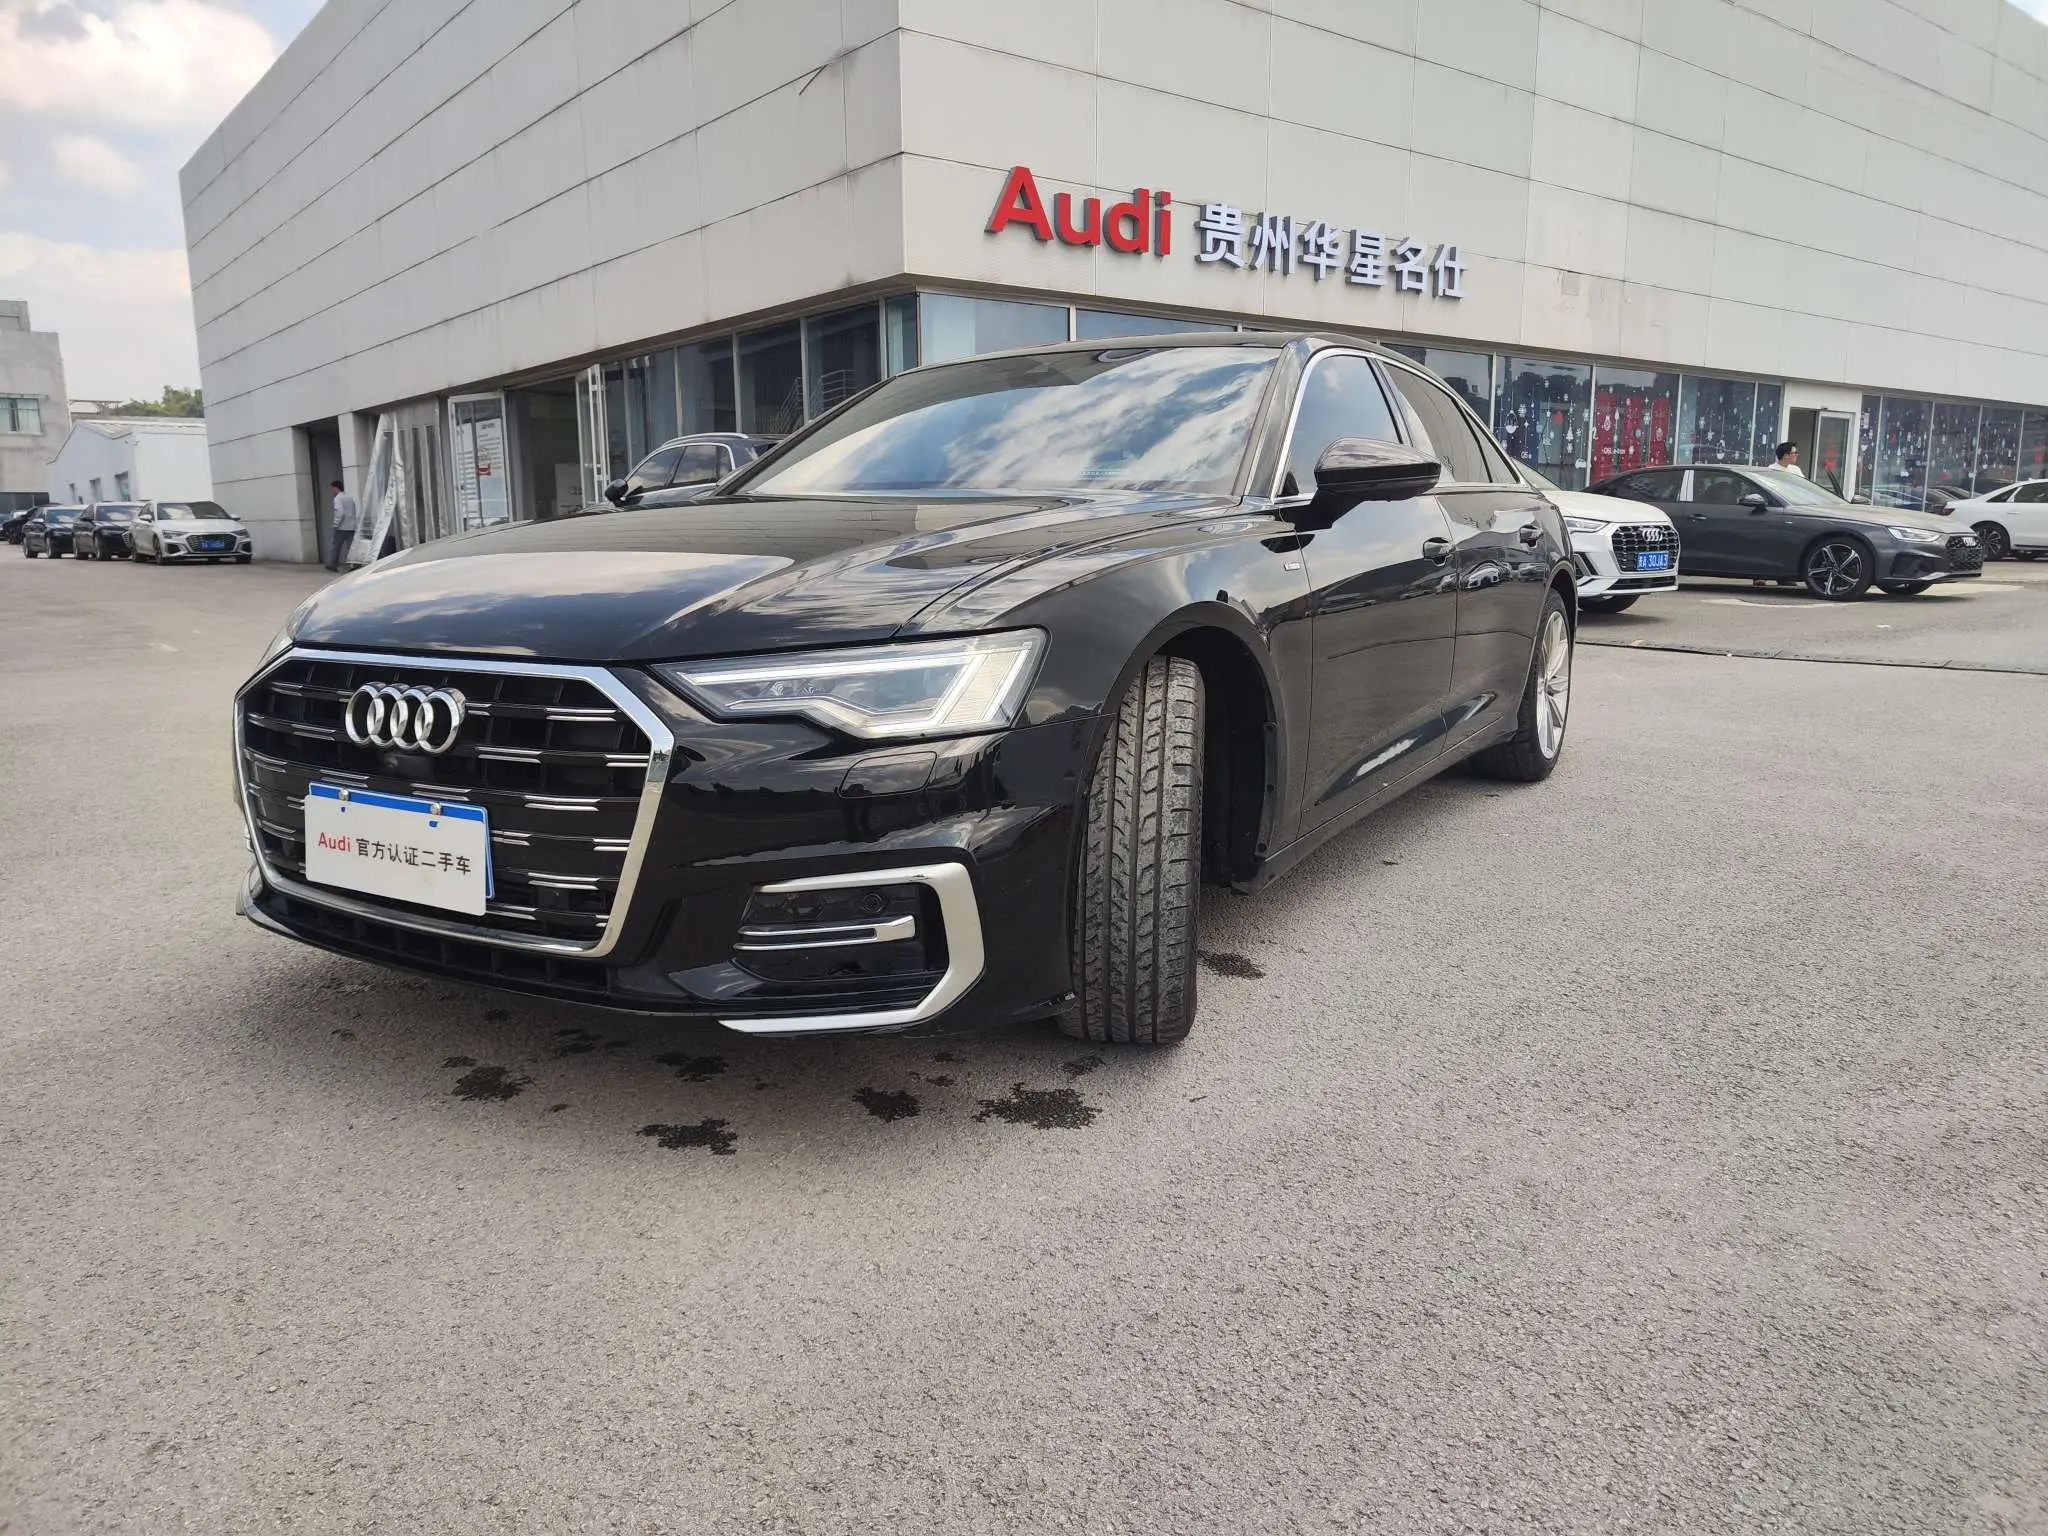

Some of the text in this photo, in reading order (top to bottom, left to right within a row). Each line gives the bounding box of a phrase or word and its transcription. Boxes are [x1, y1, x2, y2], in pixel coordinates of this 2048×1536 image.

[985, 166, 1171, 257] Audi
[1195, 203, 1470, 300] 贵州华星名仕
[318, 832, 471, 875] Audi 官方认证二手车
